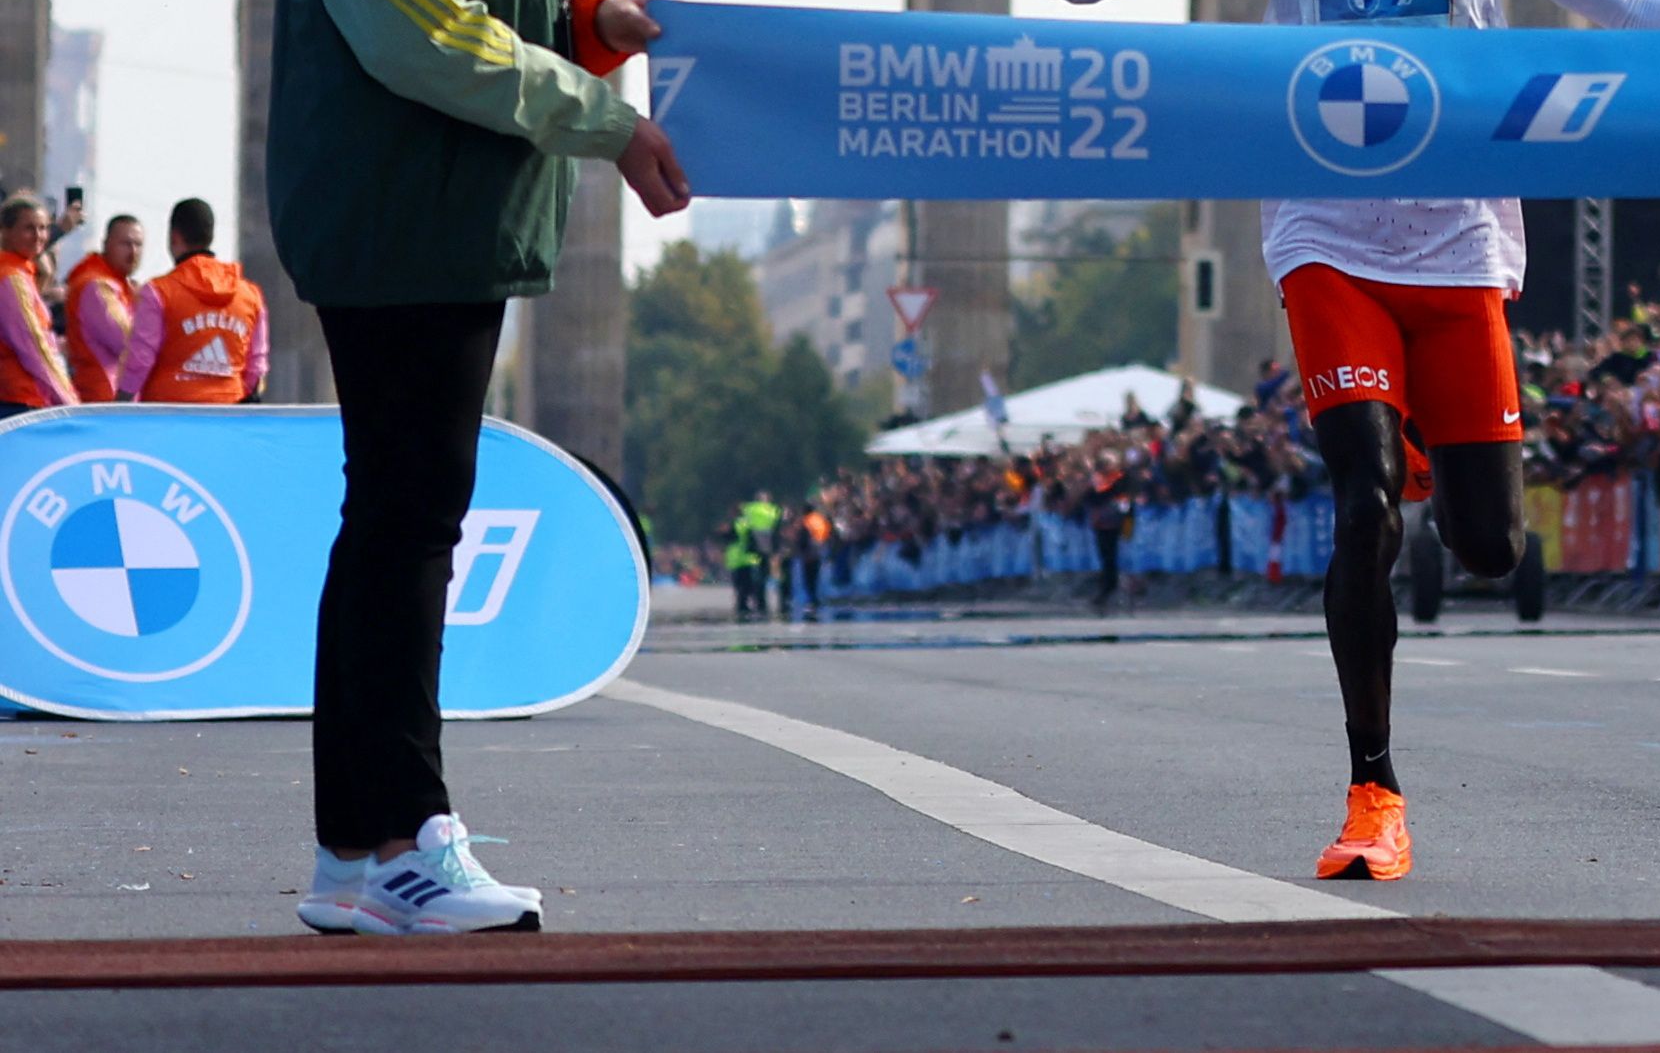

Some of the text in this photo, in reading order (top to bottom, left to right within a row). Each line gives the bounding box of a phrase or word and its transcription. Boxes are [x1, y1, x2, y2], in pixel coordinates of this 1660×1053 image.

[839, 44, 1150, 101] BMW 20
[1308, 47, 1418, 79] BMW
[839, 92, 979, 122] BERLIN
[838, 128, 1061, 158] MARATHON
[1068, 106, 1149, 160] 22
[182, 312, 247, 338] BERLIN
[1308, 366, 1390, 399] INEOS
[26, 463, 206, 530] BMW
